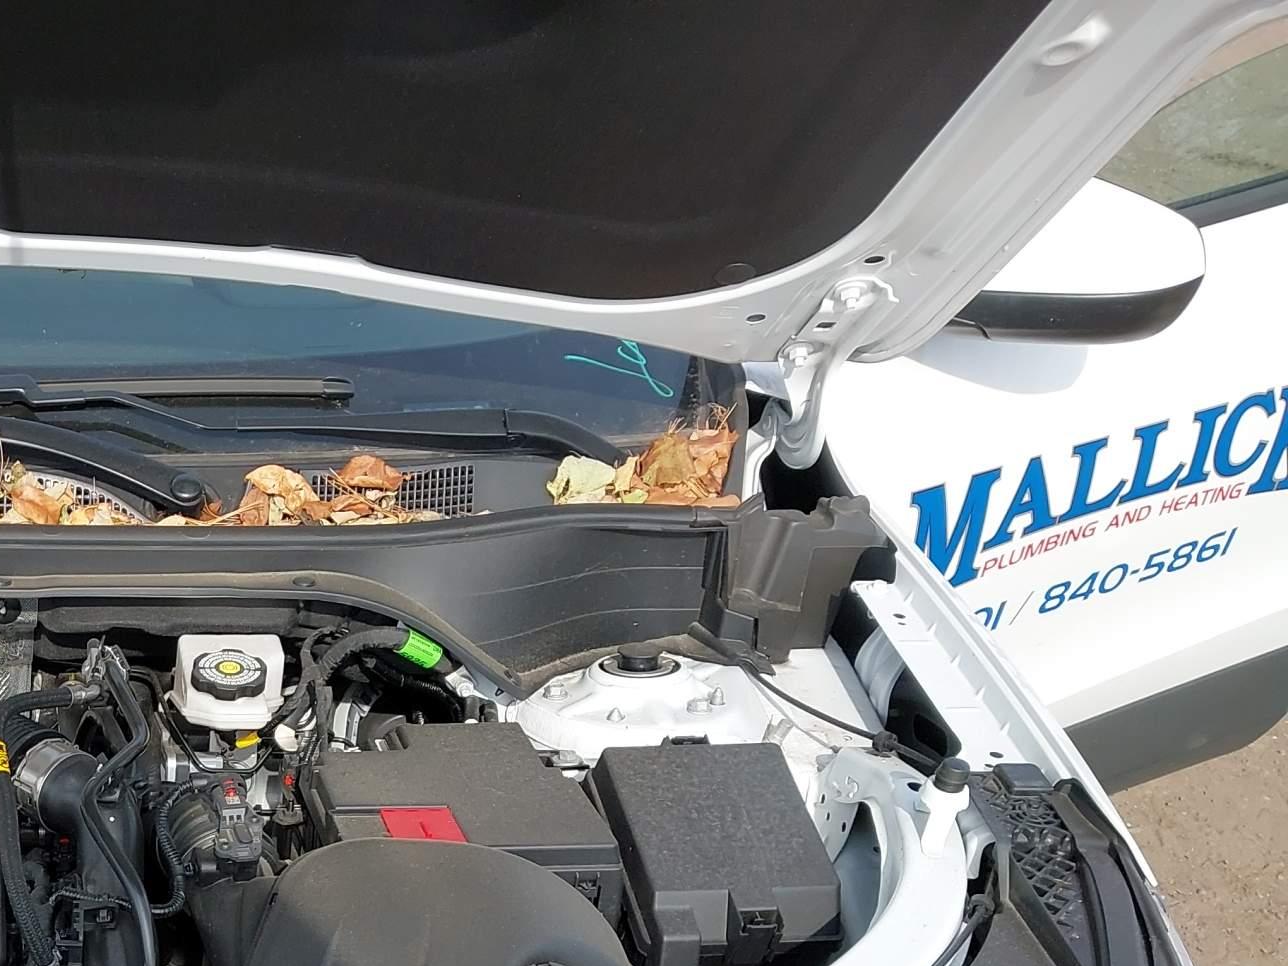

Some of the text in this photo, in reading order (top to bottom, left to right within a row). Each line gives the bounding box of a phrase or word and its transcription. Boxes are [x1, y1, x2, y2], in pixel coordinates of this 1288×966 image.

[980, 482, 1245, 577] PLUMBING AND HEATING
[1038, 527, 1238, 614] 840-5861
